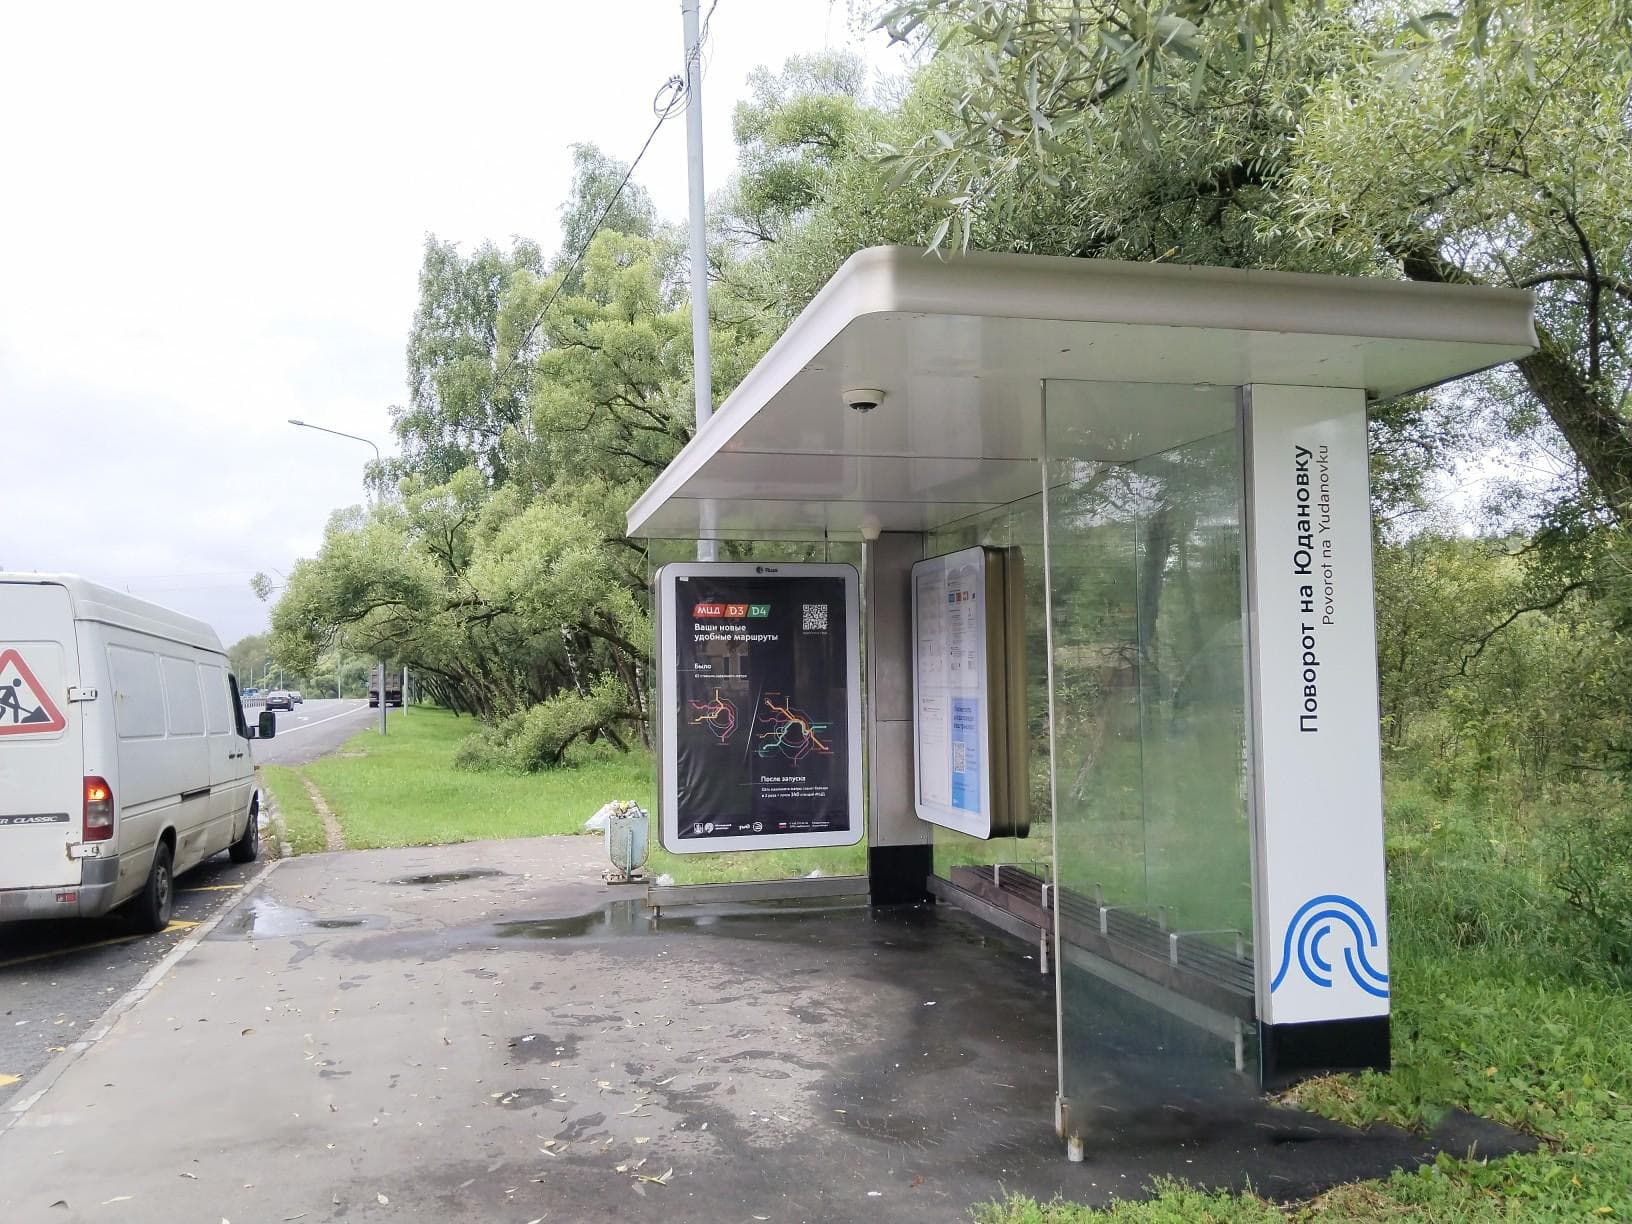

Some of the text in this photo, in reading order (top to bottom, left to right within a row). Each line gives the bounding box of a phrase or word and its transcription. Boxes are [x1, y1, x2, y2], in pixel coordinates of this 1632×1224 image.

[1316, 445, 1334, 625] Povorot na Yudanovku
[1293, 445, 1320, 732] Поворот на Юдановку
[728, 606, 744, 616] D3
[752, 606, 767, 616] D4
[694, 623, 718, 631] Ваши
[694, 632, 778, 642] удобные маршруты
[13, 816, 58, 824] CLASSIC
